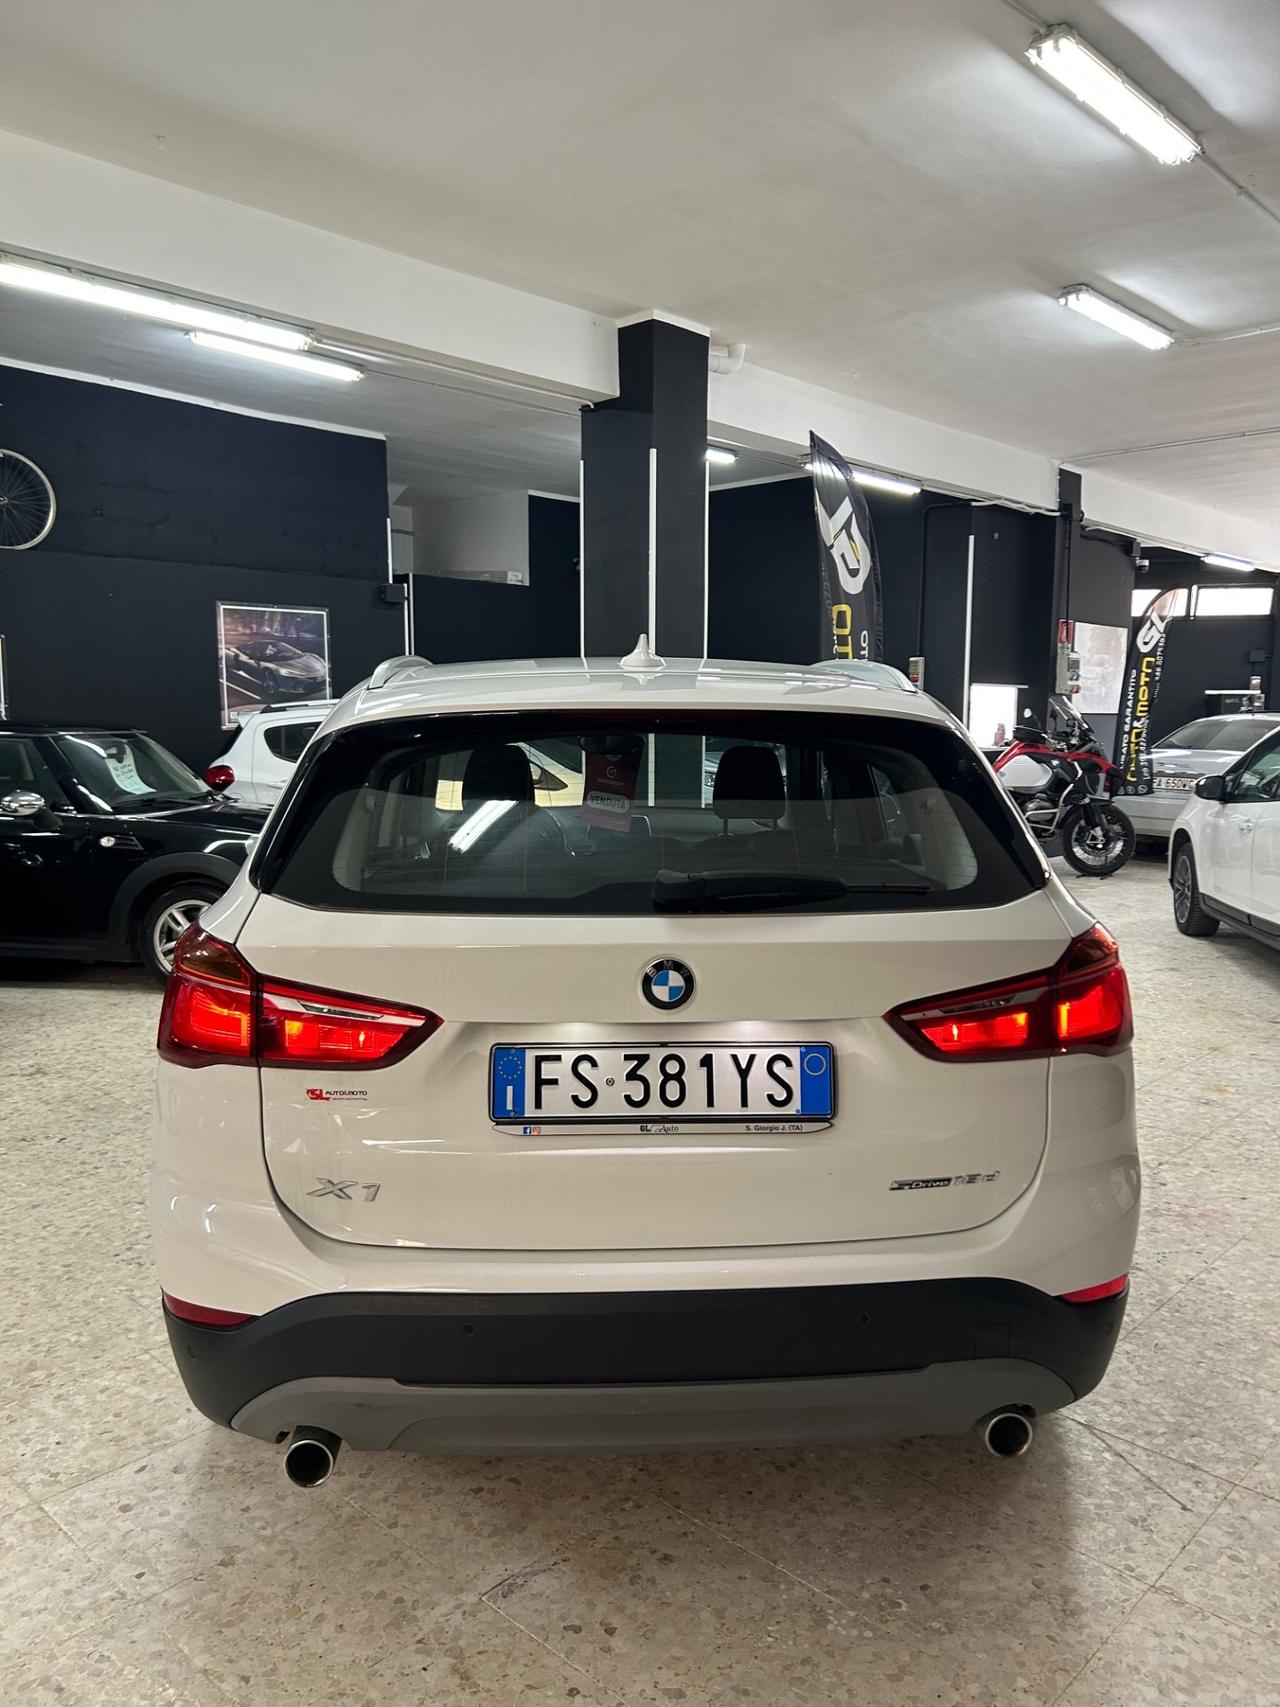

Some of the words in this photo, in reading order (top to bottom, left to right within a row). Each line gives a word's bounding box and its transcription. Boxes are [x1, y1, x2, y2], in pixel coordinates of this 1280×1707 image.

[1123, 669, 1137, 732] GARANTITO
[534, 1053, 599, 1109] FS
[622, 1053, 794, 1109] 381YS
[753, 1124, 780, 1132] Giorgio
[306, 1177, 381, 1202] X1
